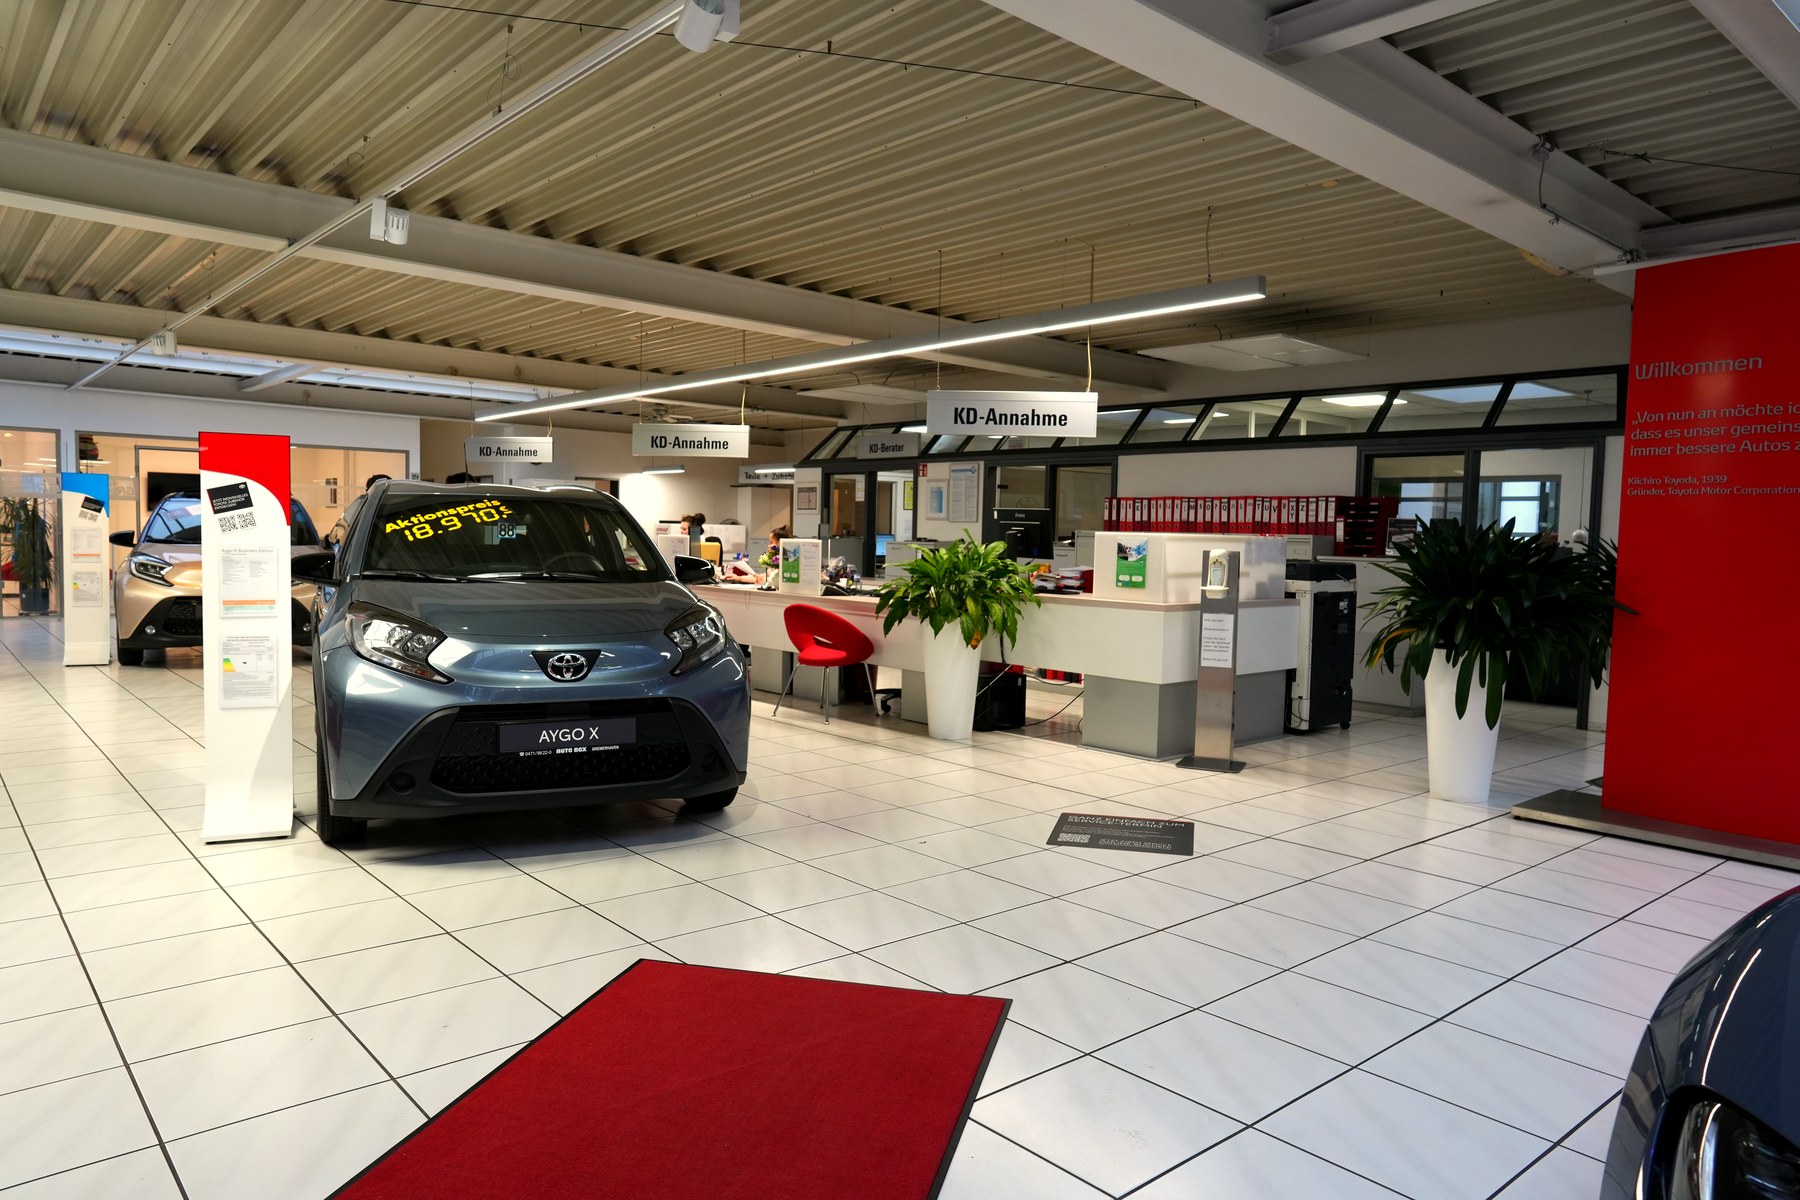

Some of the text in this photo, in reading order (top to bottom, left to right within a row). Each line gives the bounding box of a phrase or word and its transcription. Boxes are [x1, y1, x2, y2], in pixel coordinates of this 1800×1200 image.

[1635, 356, 1763, 380] Willkommen
[954, 407, 1068, 427] KD-Annahme
[1667, 410, 1695, 421] nun
[1698, 408, 1717, 418] an
[1720, 404, 1784, 418] möchte
[1631, 428, 1662, 440] dass
[1665, 429, 1681, 438] es
[1684, 426, 1728, 438] unser
[650, 436, 729, 450] KD-Annahme
[869, 443, 905, 454] KD-Berater
[1630, 445, 1673, 456] immer
[1676, 442, 1736, 455] bessere
[1740, 440, 1790, 452] Autos
[479, 446, 538, 457] KD-Annahme
[1664, 476, 1699, 486] Toyoda,
[1702, 475, 1728, 484] 1939
[1627, 485, 1800, 498] Gründer, Toyota Motor Corporation
[386, 500, 500, 533] Aktionspreis
[498, 523, 514, 536] 88
[539, 726, 599, 743] AYGO X
